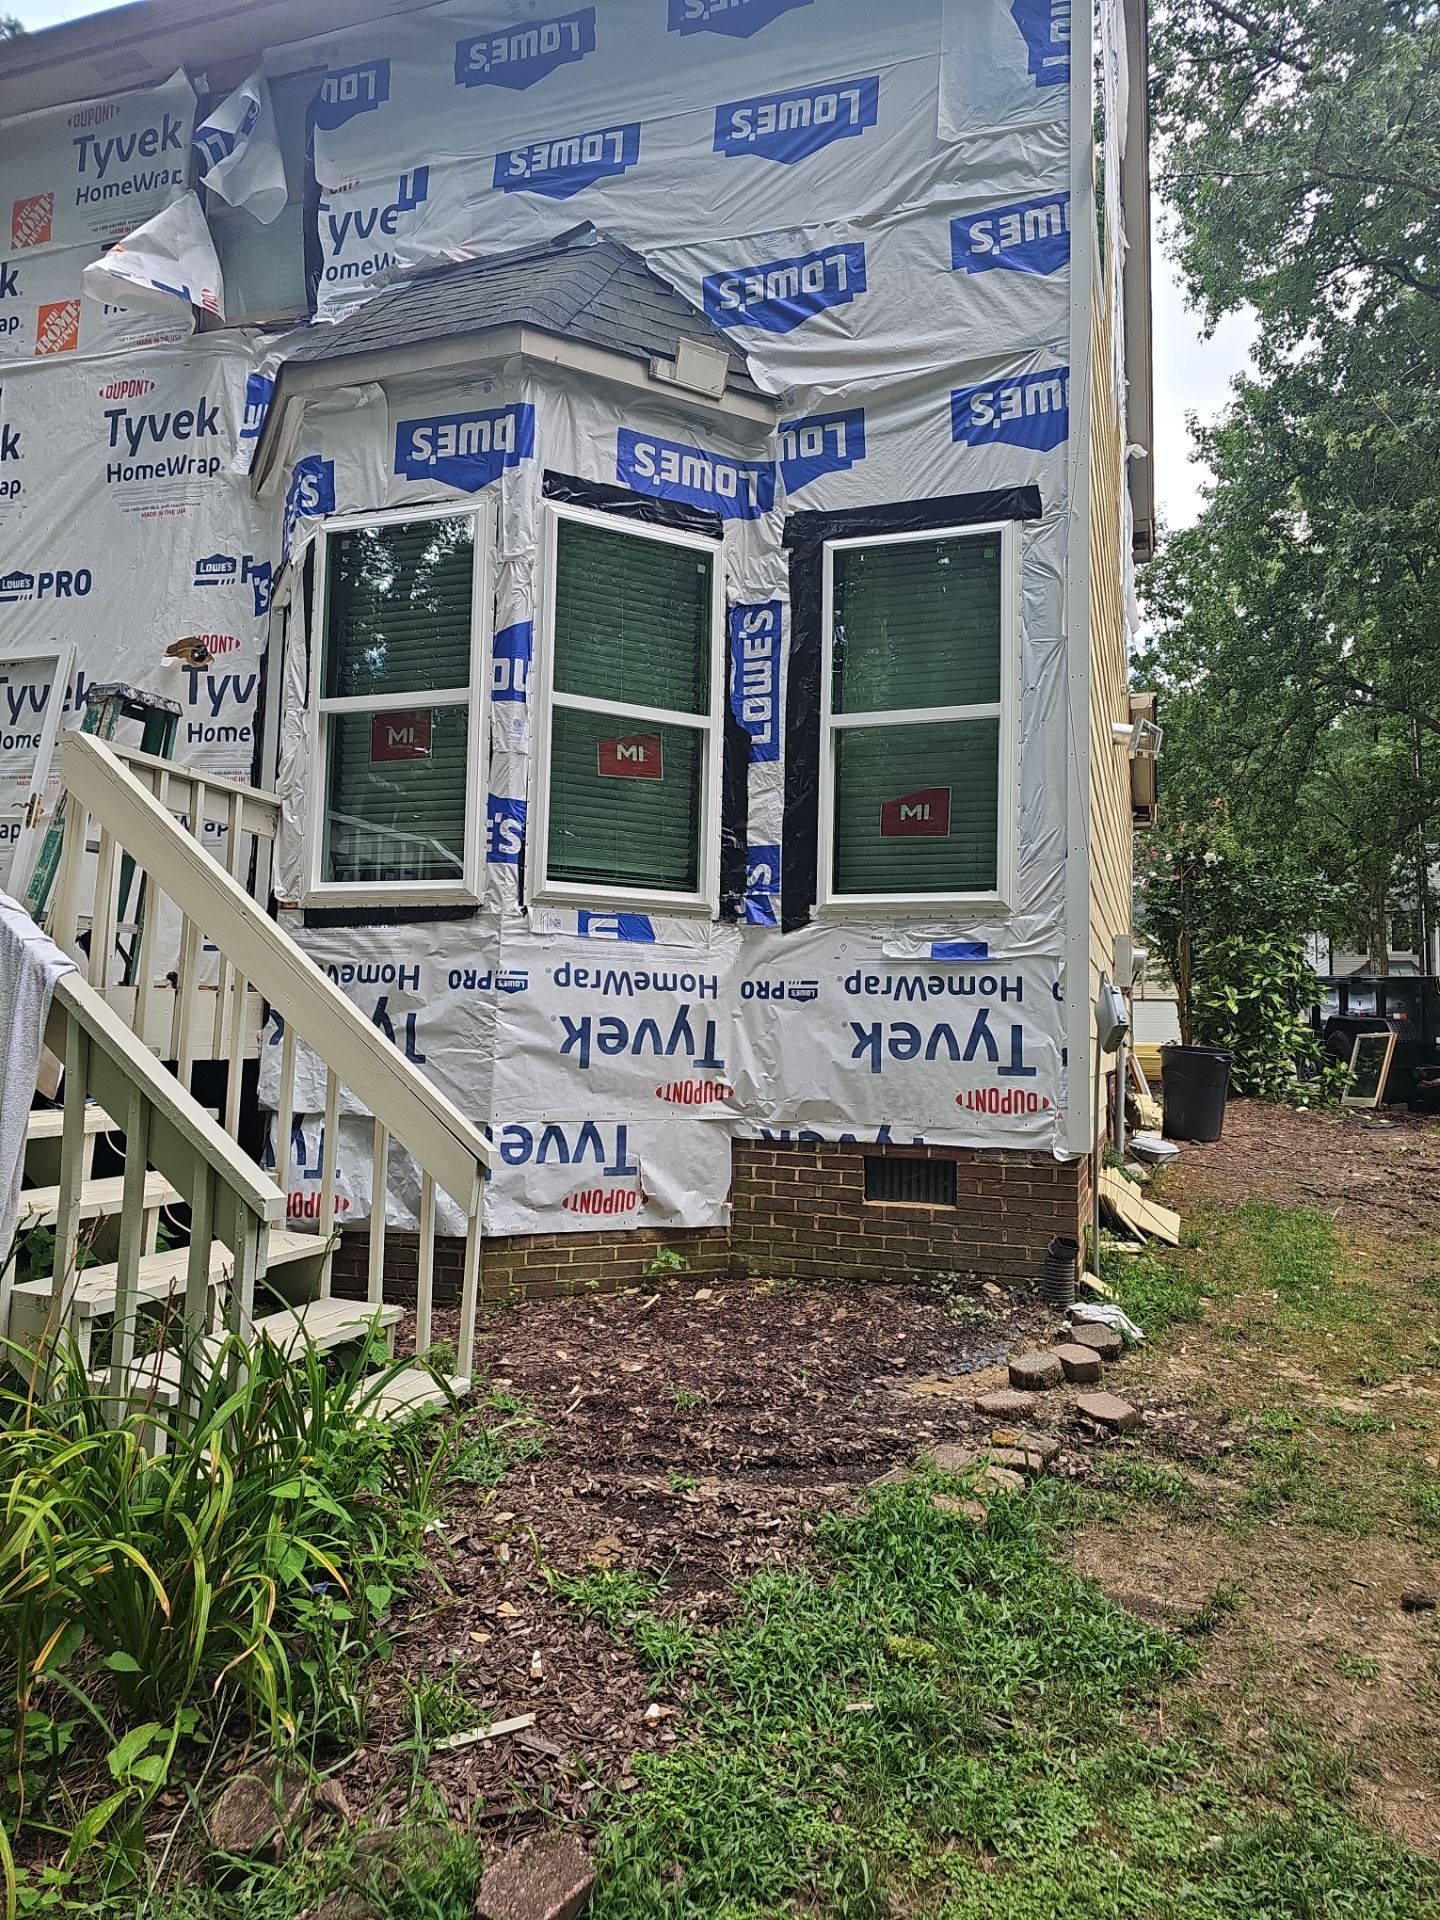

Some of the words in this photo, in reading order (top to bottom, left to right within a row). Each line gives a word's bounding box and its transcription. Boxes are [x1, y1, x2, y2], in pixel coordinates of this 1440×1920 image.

[468, 21, 580, 72] LOWE'S
[73, 105, 115, 128] DUPONT
[731, 88, 861, 142] LOWE'S
[72, 113, 183, 179] Tyvek
[508, 130, 625, 179] LOWE'S
[12, 193, 52, 249] HOME
[16, 203, 34, 224] THE
[719, 254, 848, 313] LOWE'S
[35, 300, 81, 354] HOME
[41, 309, 60, 331] THE
[52, 318, 80, 352] DEPOT
[106, 379, 149, 400] DUPONT
[104, 396, 220, 457] Tyvek
[106, 454, 221, 484] HomeWrap
[634, 442, 759, 508] LOWE'S
[176, 507, 186, 515] USA
[200, 561, 233, 573] LOWE'S
[1, 578, 31, 590] LOWE'S
[37, 569, 92, 599] PRO
[199, 635, 234, 654] PONT
[743, 608, 774, 744] LOWE'S
[388, 727, 414, 745] MI
[616, 743, 644, 762] MI
[900, 804, 930, 821] MI
[448, 970, 492, 990] PRO
[553, 962, 718, 999] HomeWrap
[741, 981, 785, 1000] PRO
[790, 989, 818, 998] LOWE'S
[844, 970, 1024, 1003] HomeWrap
[559, 1004, 725, 1069] Tyvek
[850, 1008, 1038, 1077] Tyvek
[665, 1080, 725, 1105] DUPONT
[965, 1087, 1038, 1115] DUPONT
[485, 1121, 638, 1181] Tyve
[570, 1188, 636, 1215] DUPONT
